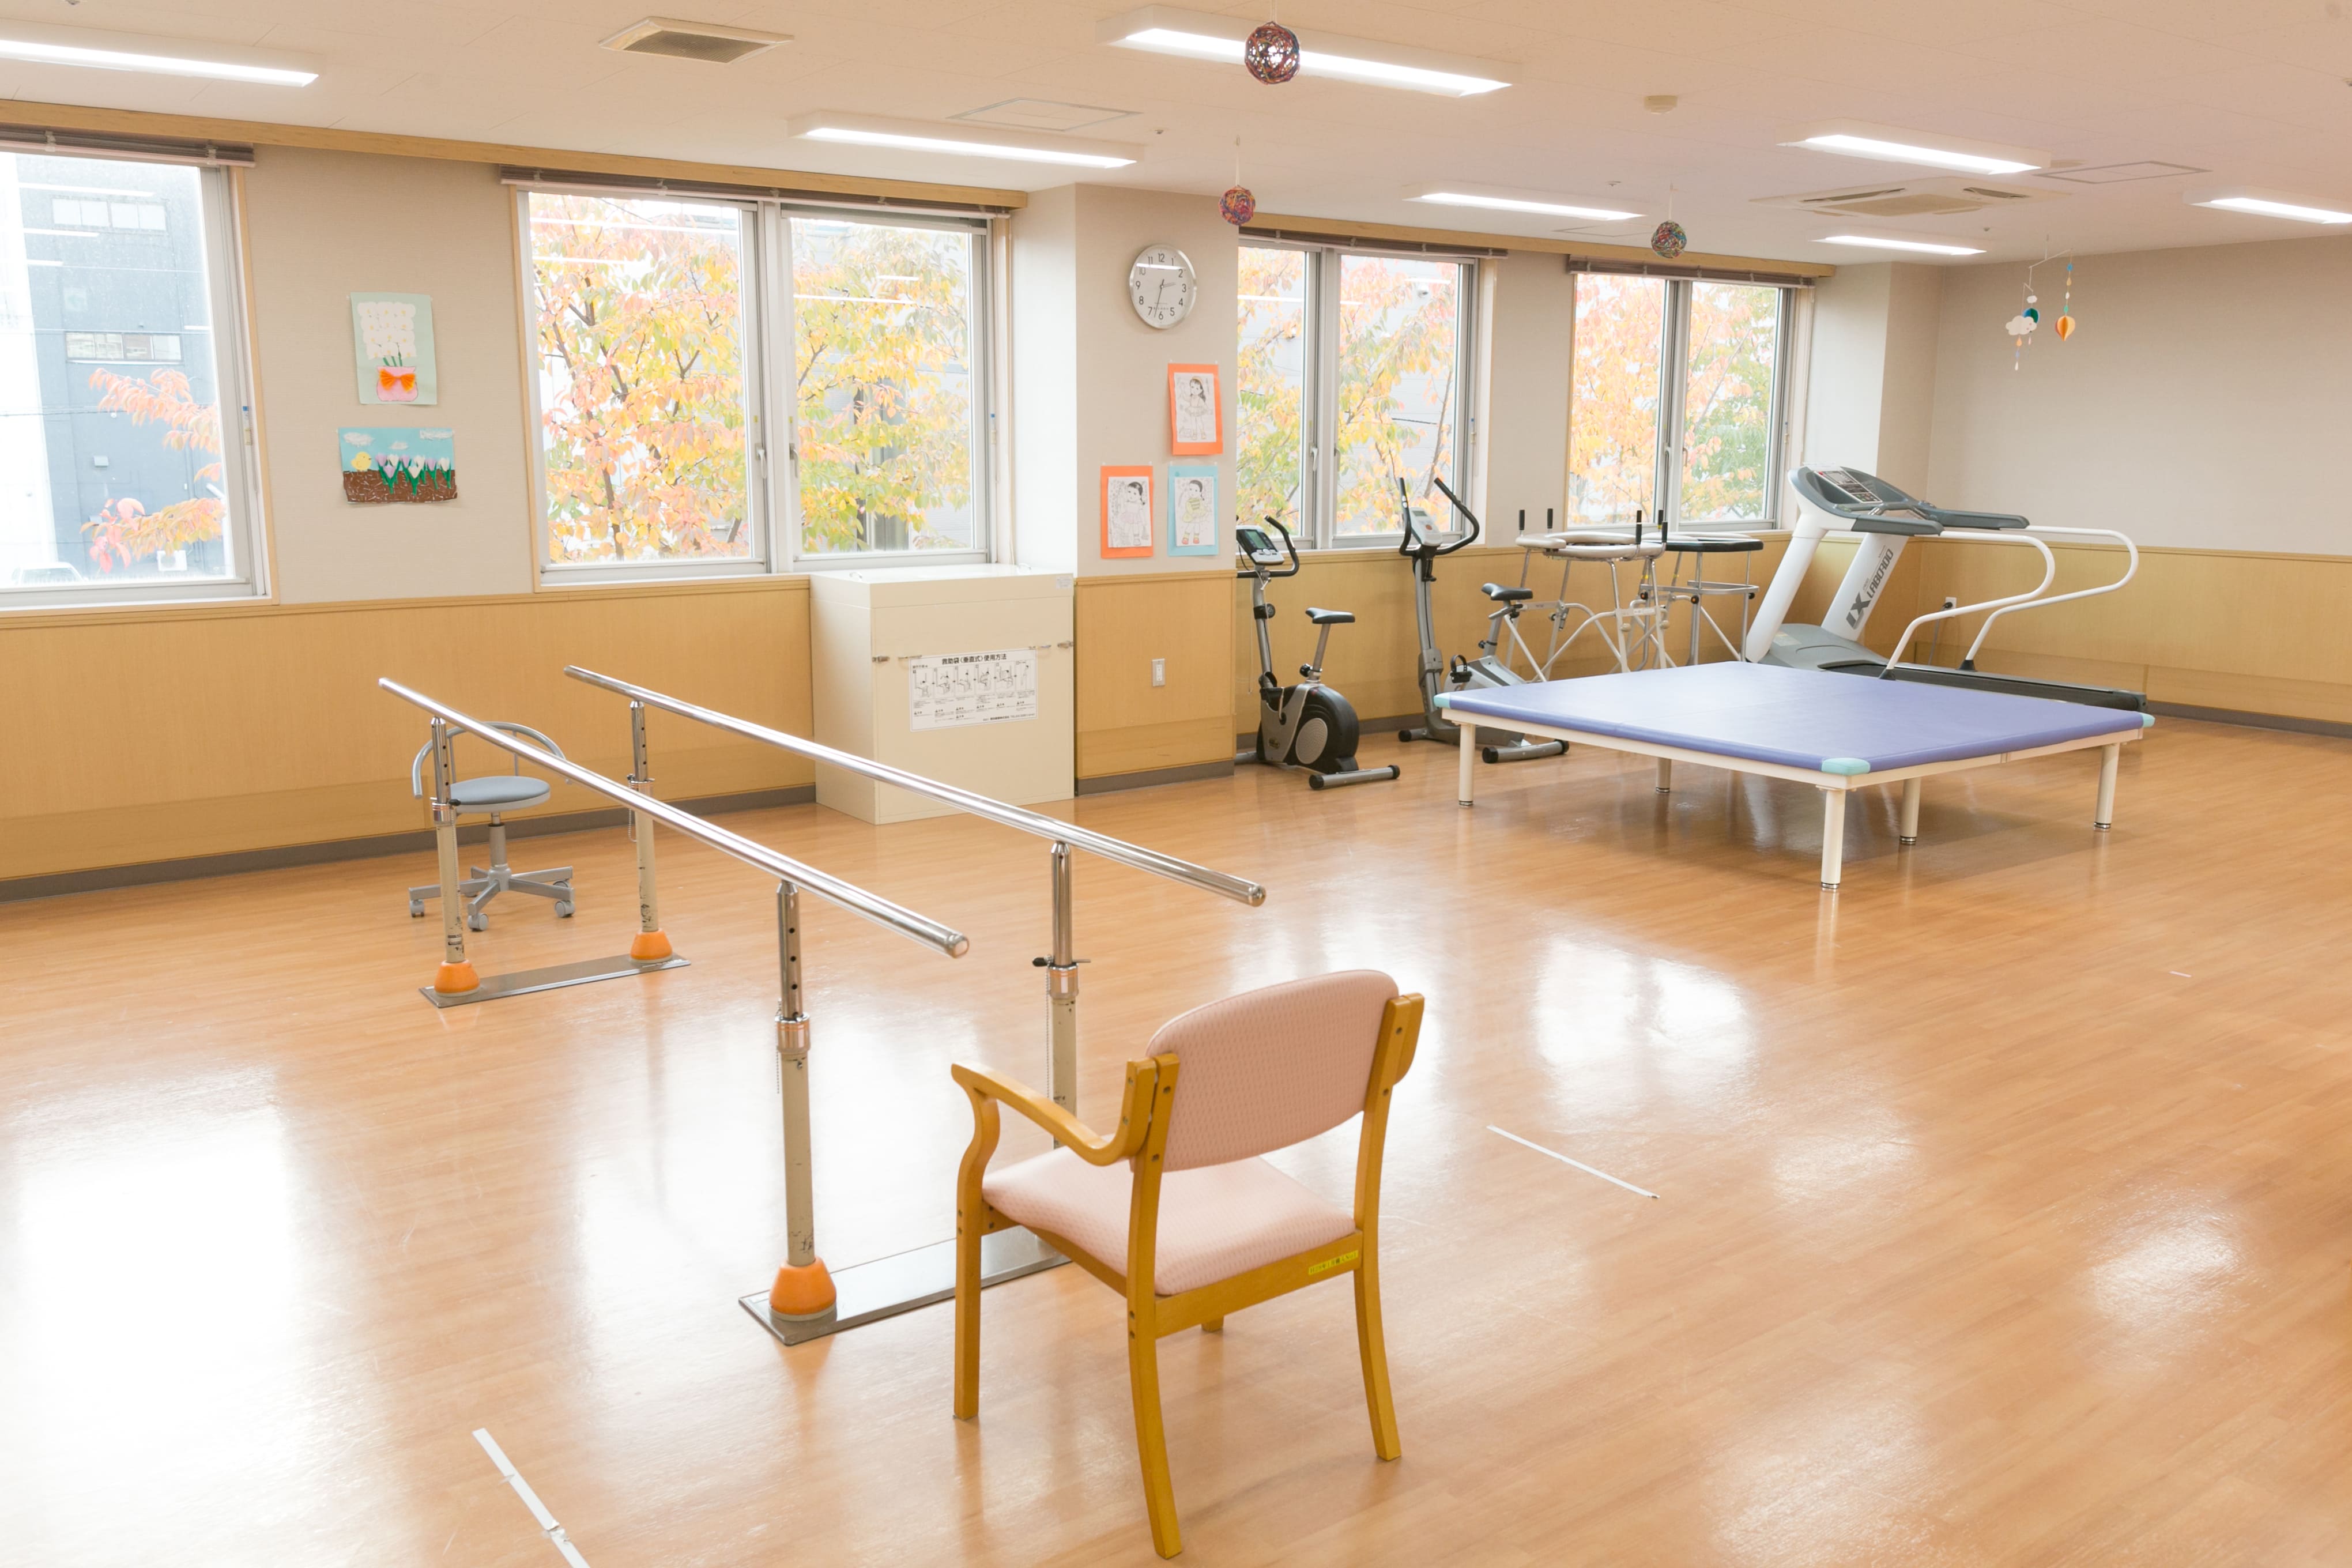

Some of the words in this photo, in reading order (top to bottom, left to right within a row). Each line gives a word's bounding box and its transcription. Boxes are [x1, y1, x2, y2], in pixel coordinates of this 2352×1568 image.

[1148, 257, 1153, 265] 11
[1158, 253, 1165, 262] 12
[1171, 258, 1174, 266] 1
[1139, 266, 1146, 276] 10
[1178, 269, 1183, 278] 2
[1136, 281, 1141, 290] 9
[1182, 284, 1186, 293] 3
[1139, 296, 1144, 305] 8
[1178, 297, 1183, 307] 4
[1148, 306, 1153, 316] 7
[1158, 311, 1163, 320] 6
[1170, 307, 1175, 316] 5
